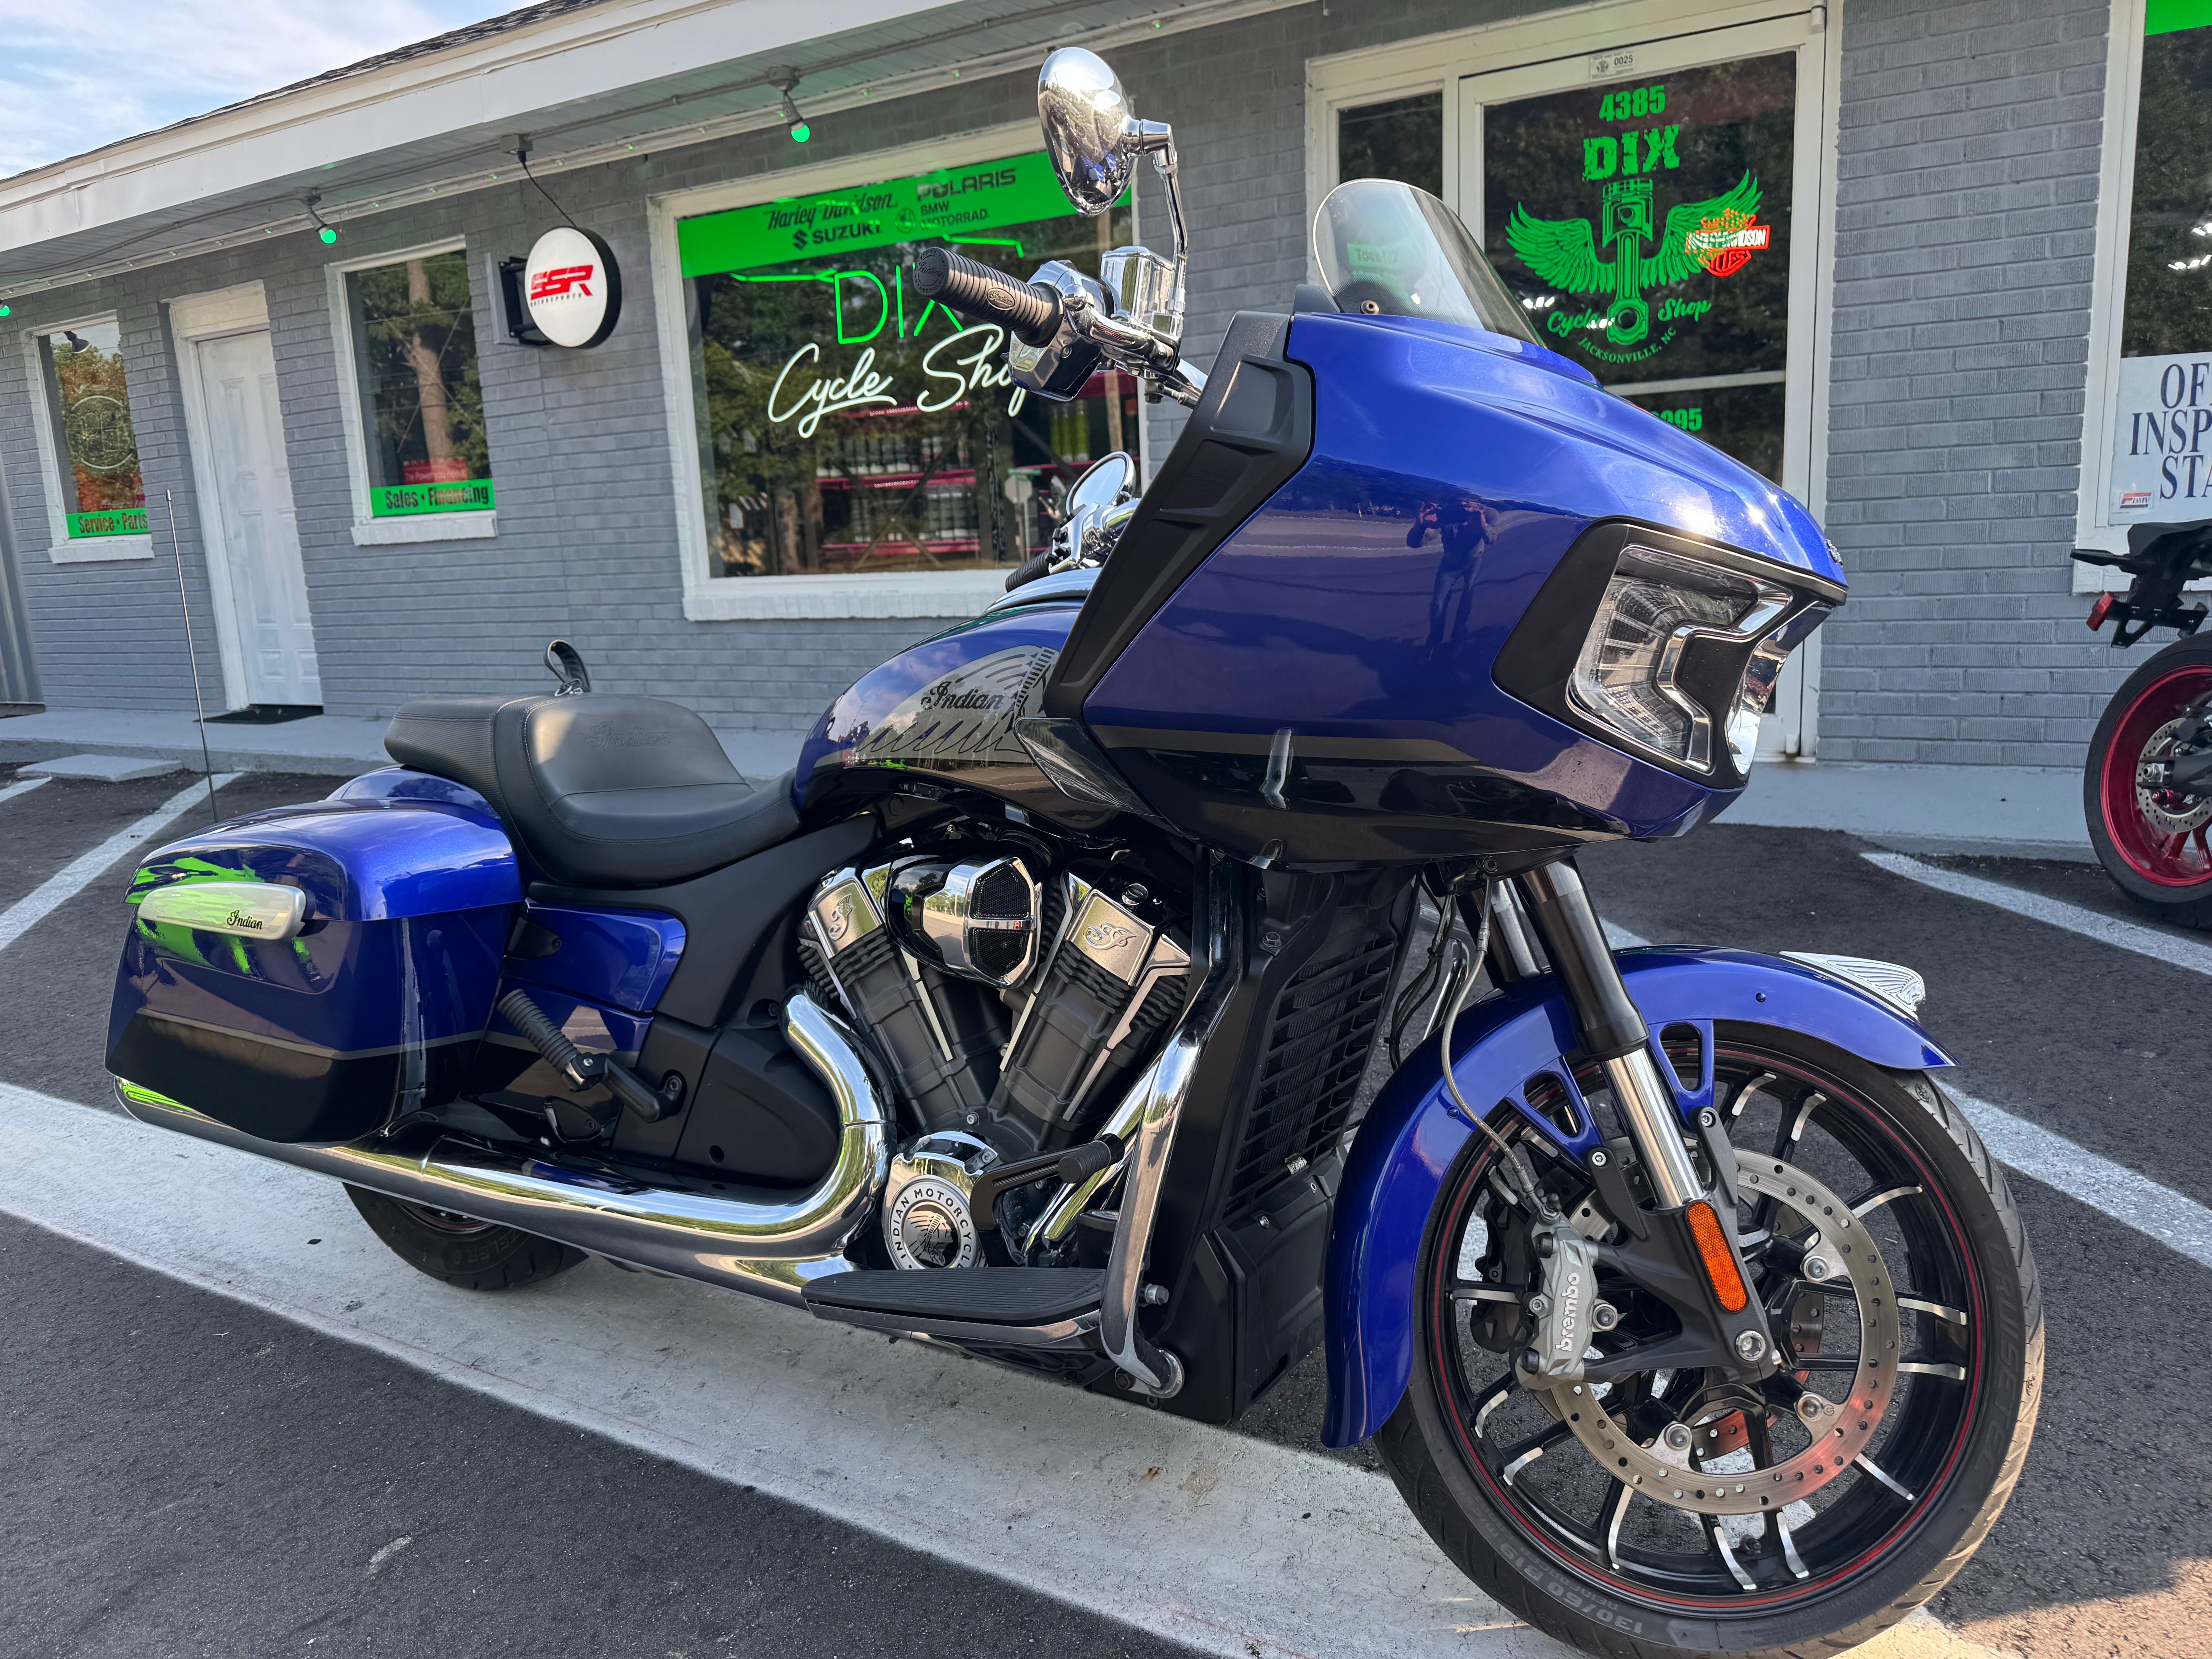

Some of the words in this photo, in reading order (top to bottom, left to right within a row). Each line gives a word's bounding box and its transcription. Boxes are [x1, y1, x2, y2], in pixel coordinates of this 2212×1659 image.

[1614, 54, 1633, 65] 0025
[1599, 85, 1666, 122] 4385
[1582, 124, 1680, 182] DIX
[917, 168, 1017, 202] POLARIS
[920, 201, 950, 215] BMW
[812, 222, 881, 244] SUZUKI
[531, 265, 593, 300] SSR
[1657, 298, 1712, 322] Shop
[1577, 337, 1662, 363] JACKSONVILLE,
[1660, 326, 1677, 345] NC
[768, 343, 897, 439] Cycle
[2160, 362, 2212, 409] OF
[385, 489, 419, 508] Sales
[428, 484, 489, 505] Financing
[78, 512, 115, 534] Service
[122, 511, 148, 531] Parts
[920, 681, 1004, 710] Indian
[227, 910, 263, 930] Indian
[893, 1197, 909, 1259] INDIAN
[1556, 1273, 1580, 1351] brembo
[1974, 1241, 2019, 1486] CRUISETEC
[1520, 1547, 1618, 1611] REINFORCED
[1547, 1582, 1643, 1634] 130/60
